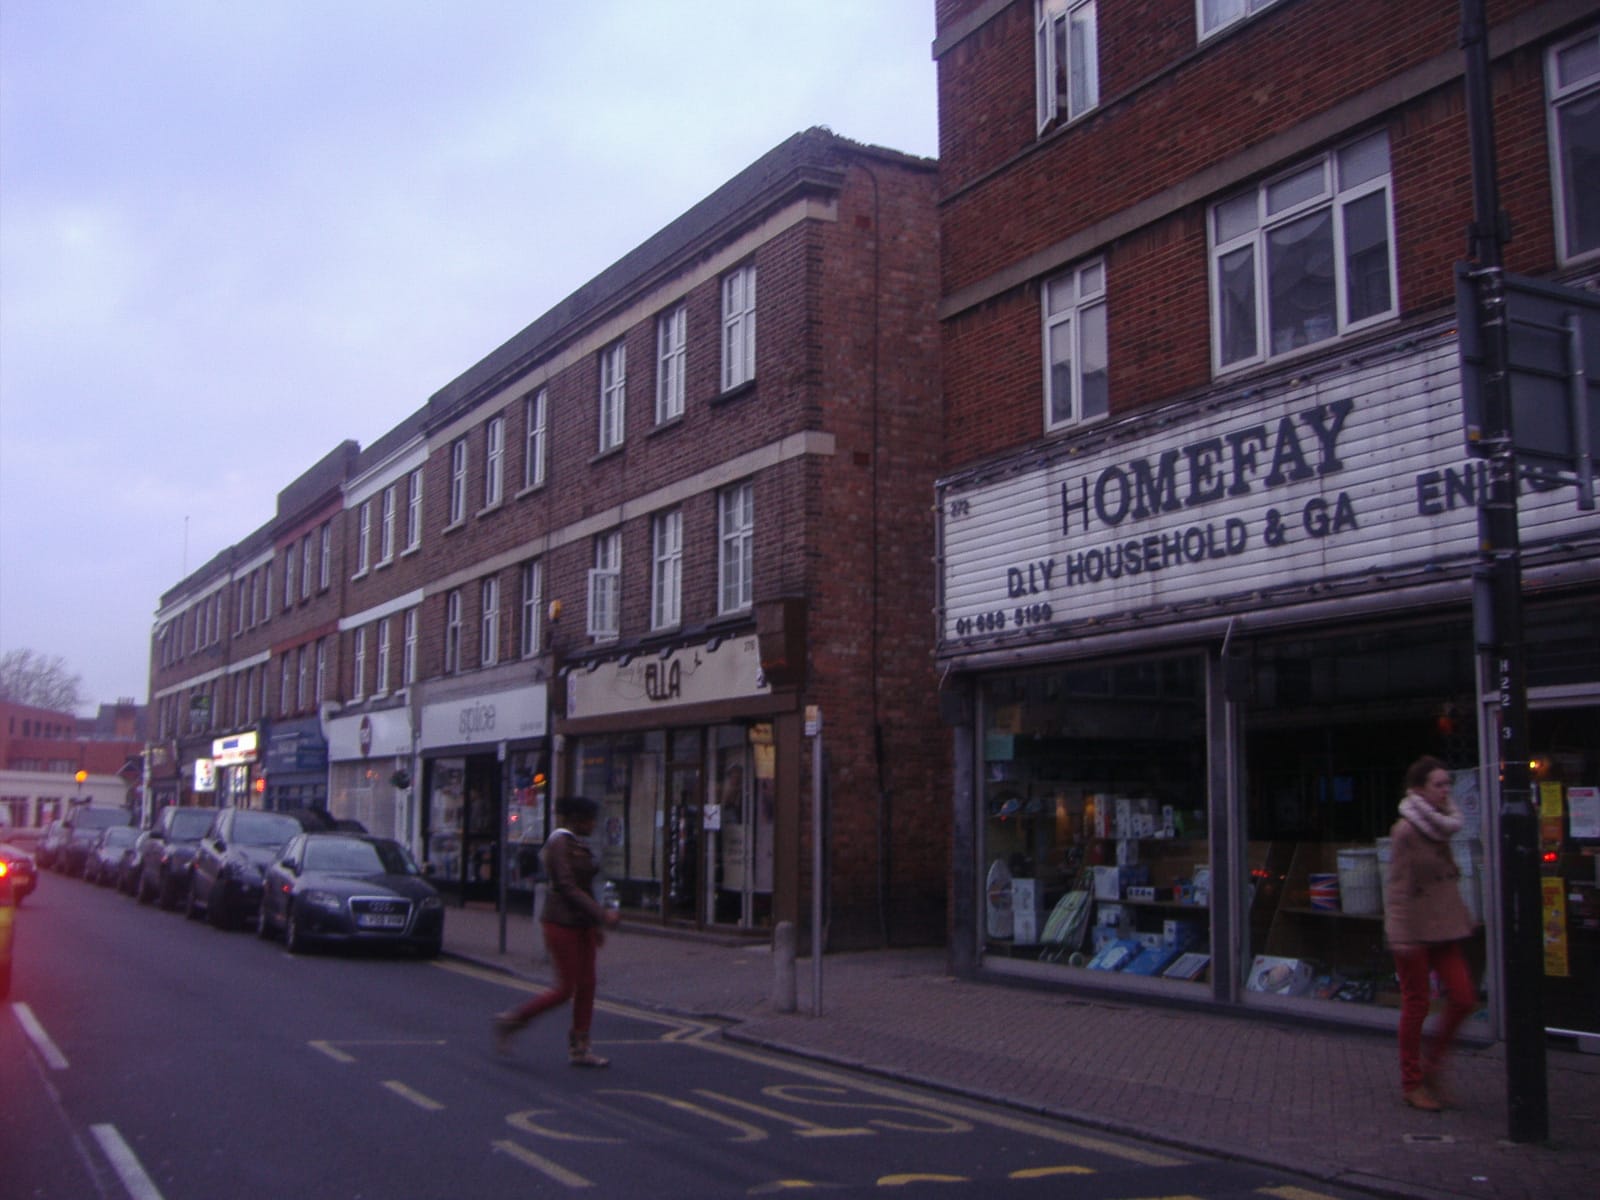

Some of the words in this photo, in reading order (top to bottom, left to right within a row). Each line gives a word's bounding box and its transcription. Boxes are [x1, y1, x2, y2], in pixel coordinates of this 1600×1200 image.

[1061, 399, 1355, 531] HOMEFAY
[1066, 517, 1247, 586] HOUSEHOLD
[1264, 509, 1287, 547] &
[1302, 493, 1359, 538] GA
